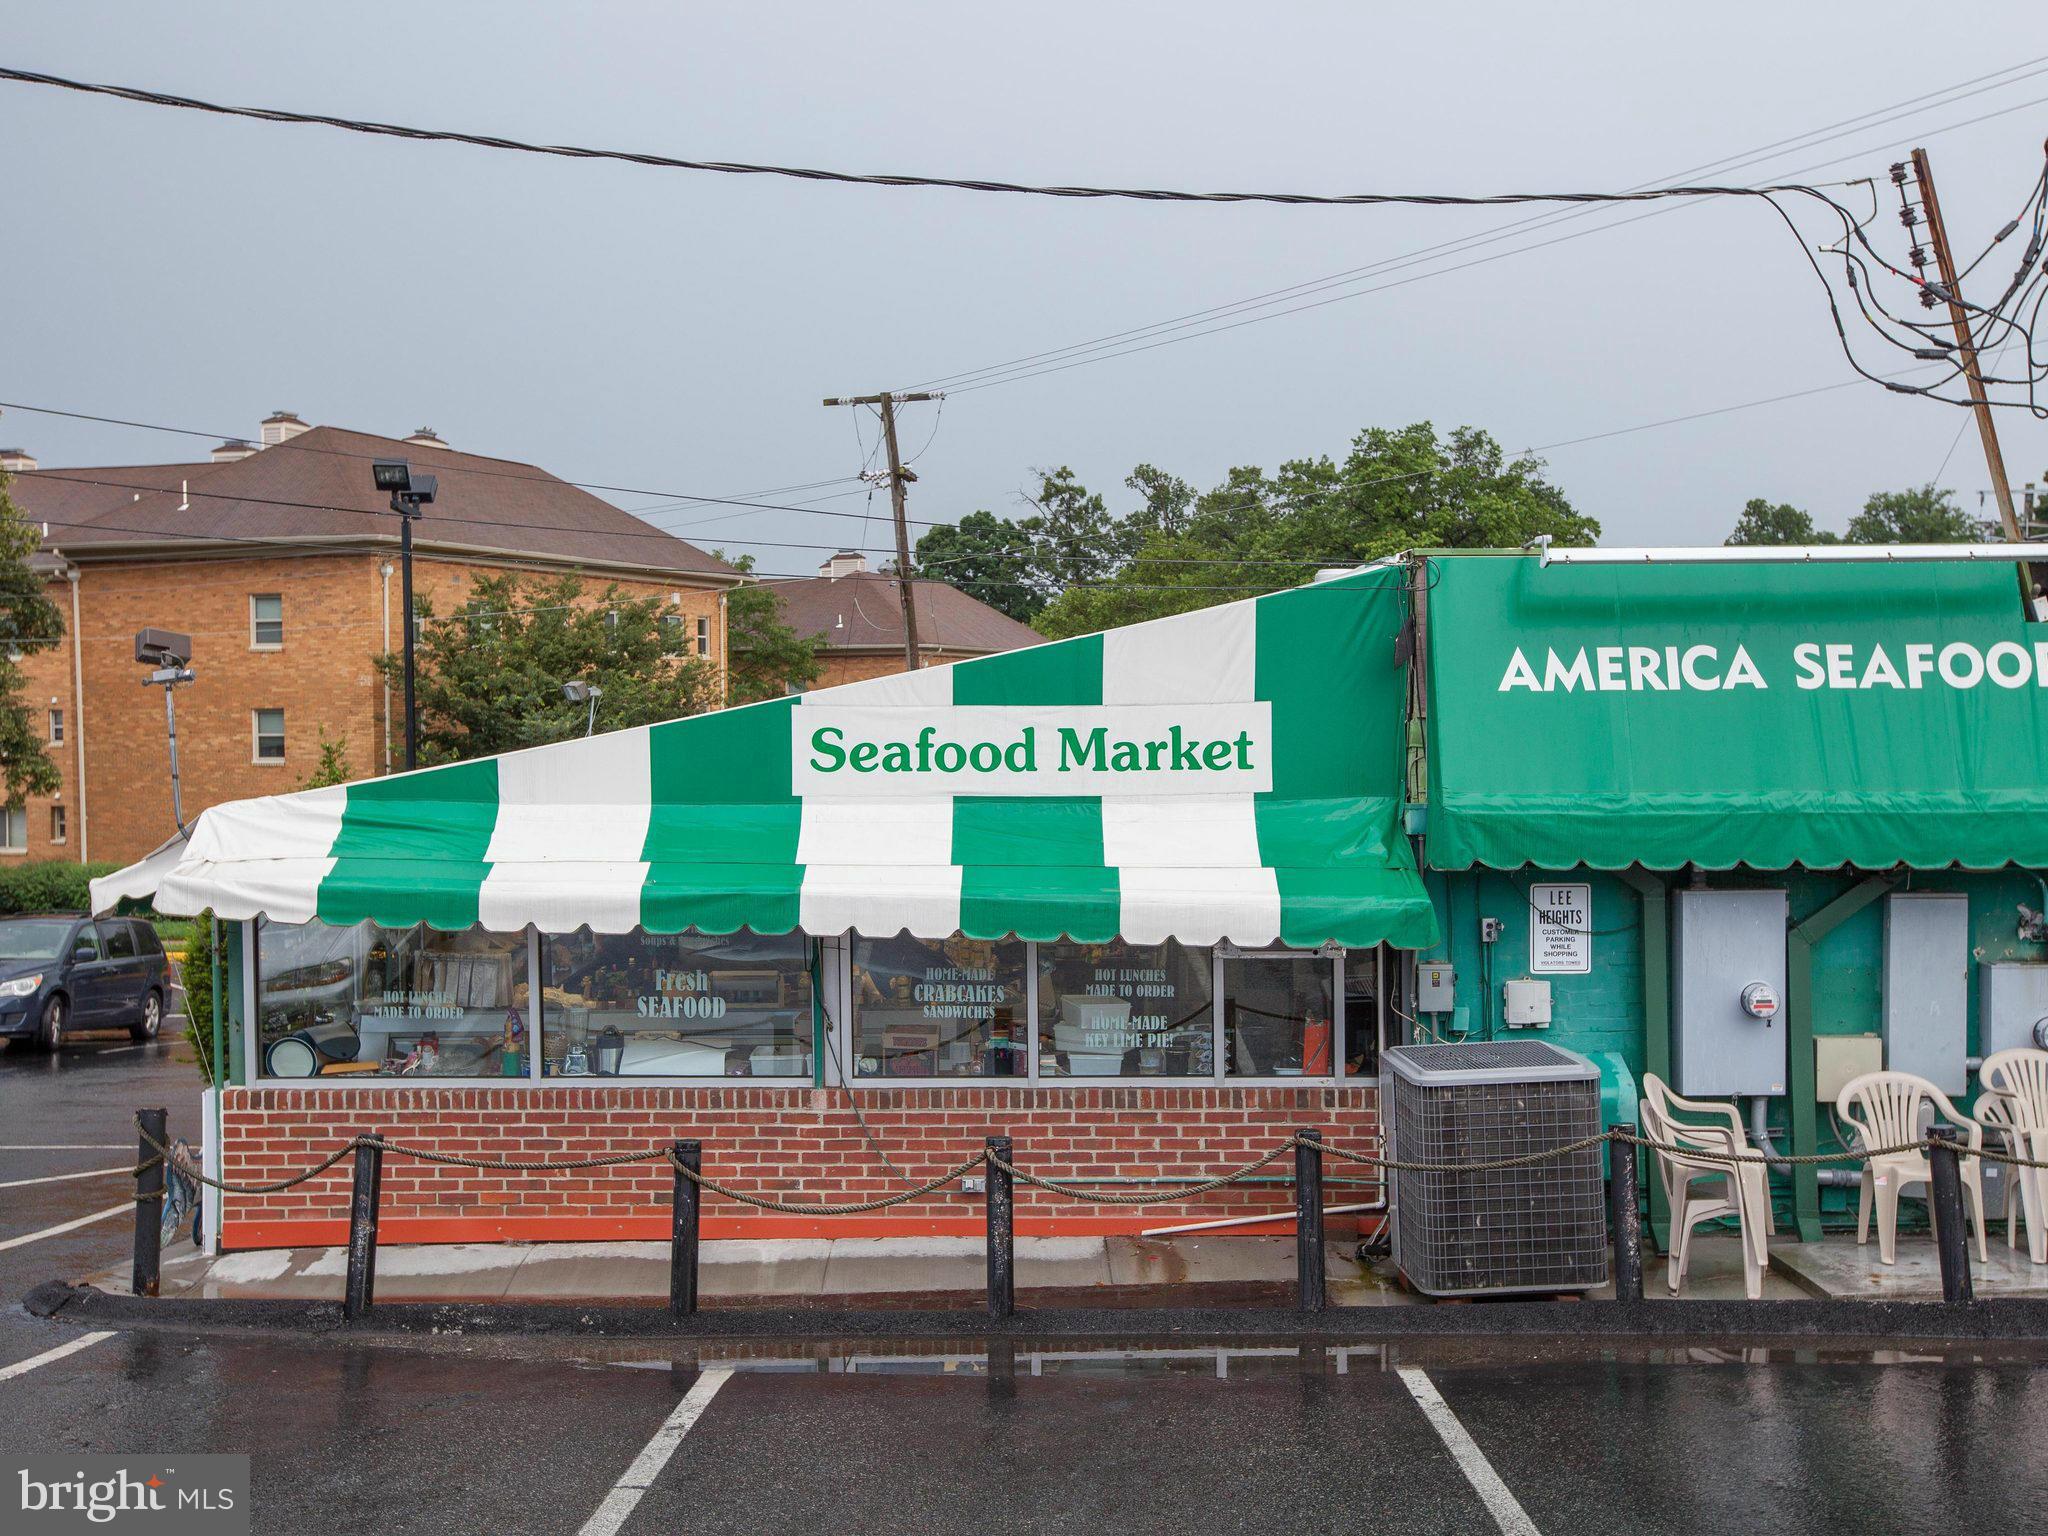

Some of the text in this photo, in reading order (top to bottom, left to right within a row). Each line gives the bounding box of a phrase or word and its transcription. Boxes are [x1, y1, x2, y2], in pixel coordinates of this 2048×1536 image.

[1498, 645, 1768, 693] AMERICA
[809, 725, 1255, 773] Seafood Market
[1550, 890, 1572, 905] LEE
[1539, 909, 1583, 925] HEIGHTS
[655, 969, 708, 991] Fresh
[926, 967, 994, 981] HOME-MADE
[1095, 968, 1166, 982] HOT LUNCHES
[383, 990, 457, 1004] HOT LUNCHES
[914, 983, 1005, 1003] CRABCAKES
[1085, 984, 1175, 998] MADE TO ORDER
[374, 1006, 465, 1019] MADE TO ORDER
[637, 995, 727, 1019] SEAFOOD
[923, 1004, 996, 1019] SANDWICHES
[1091, 1015, 1168, 1030] HOME-MADE
[1085, 1032, 1174, 1048] KEY LIME PIE!
